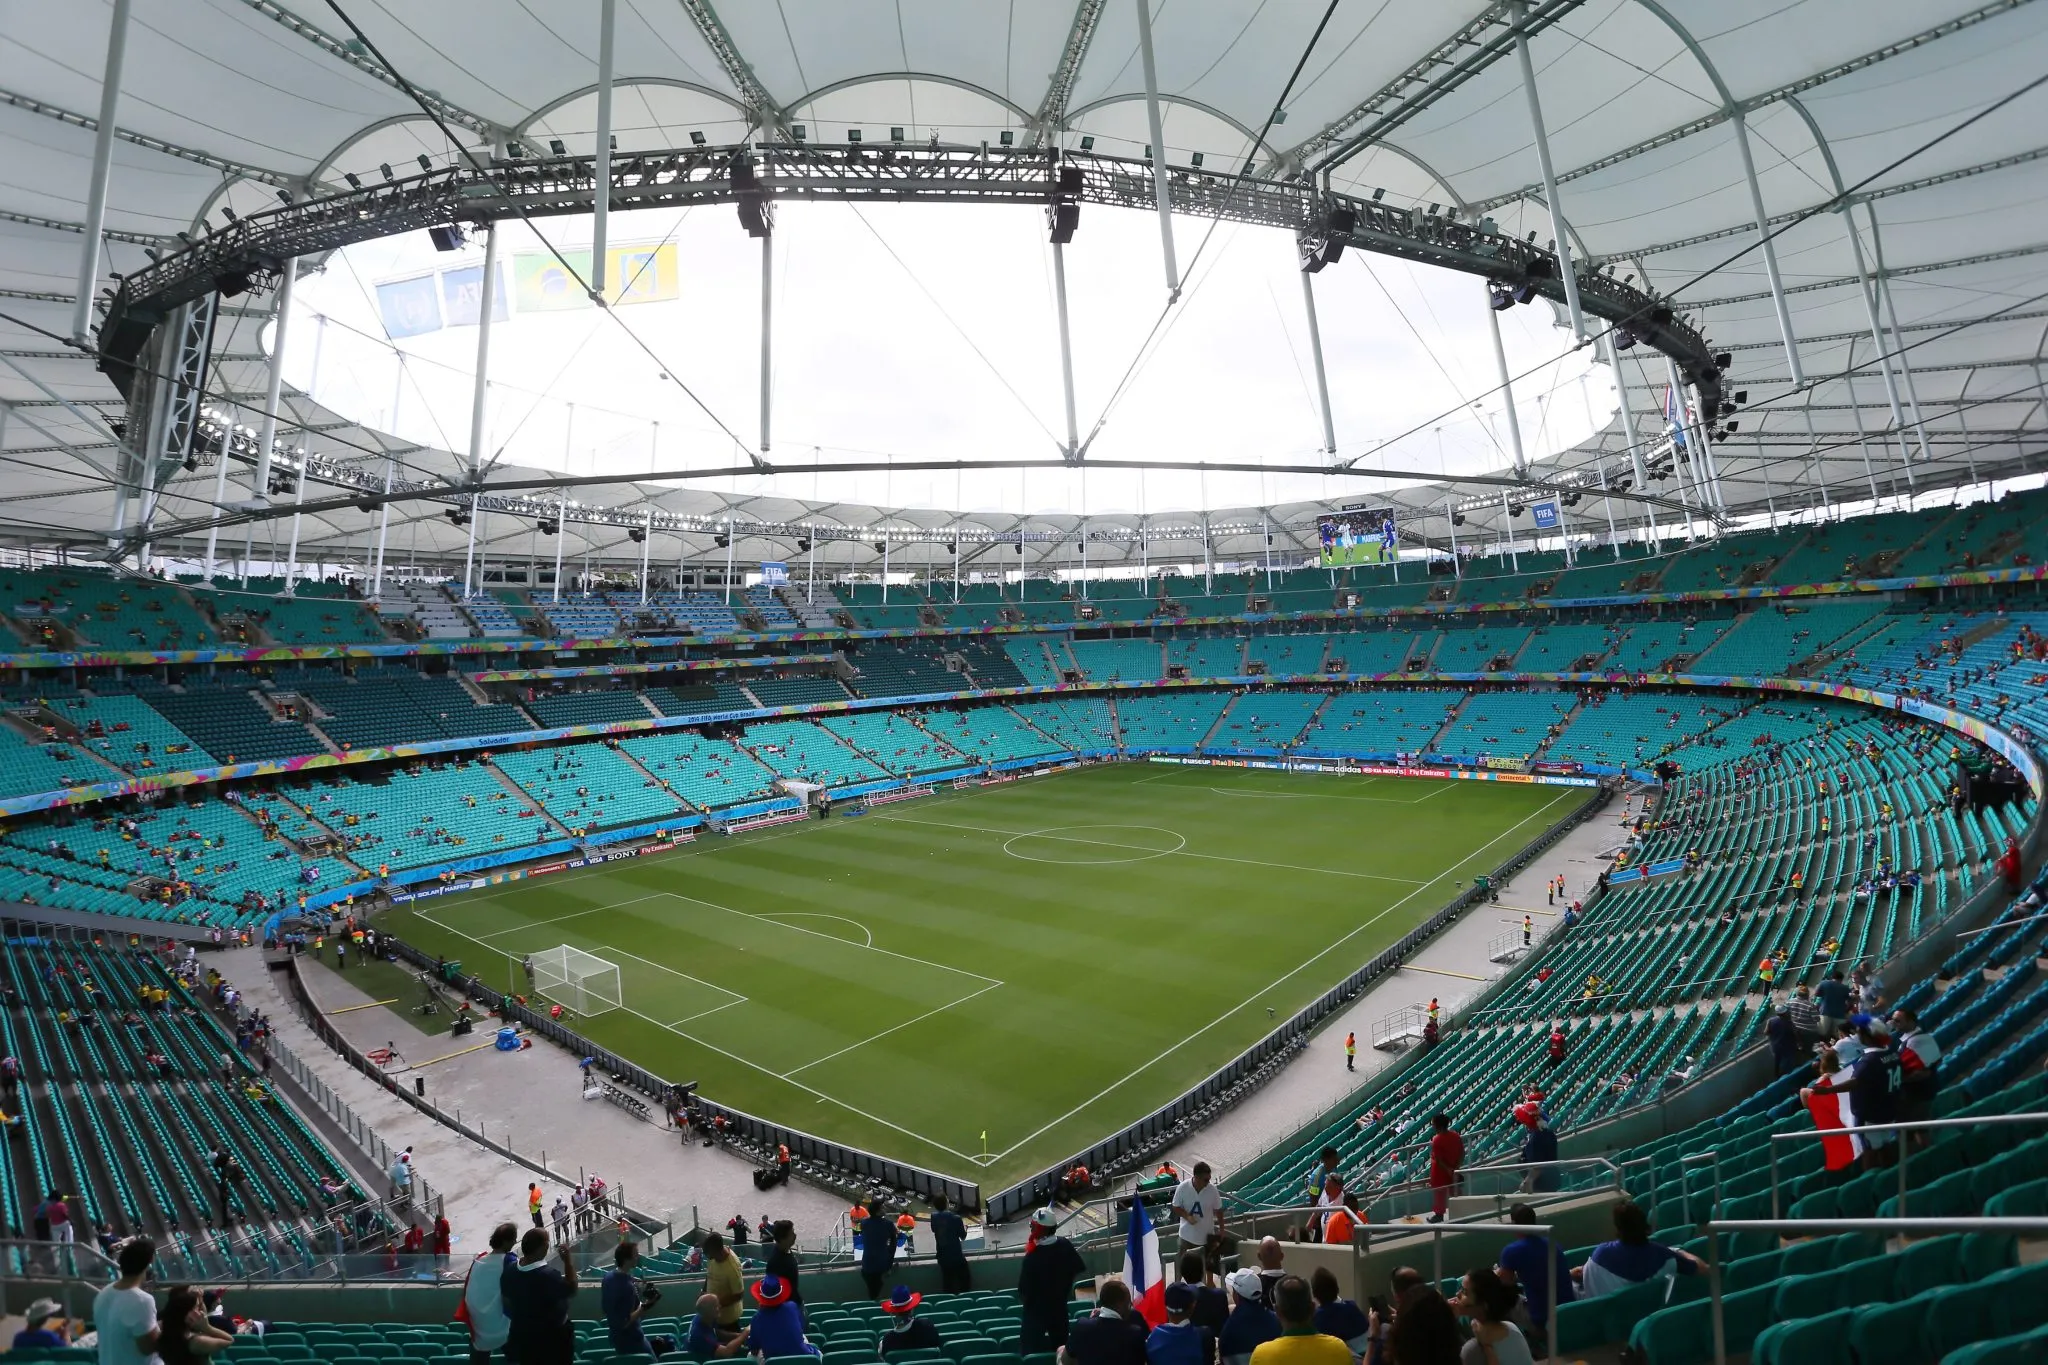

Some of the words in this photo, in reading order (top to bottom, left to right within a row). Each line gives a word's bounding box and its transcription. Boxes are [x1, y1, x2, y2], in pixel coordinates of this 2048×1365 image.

[1536, 508, 1554, 519] FIFA
[764, 567, 784, 577] FIFA
[713, 713, 729, 721] World
[478, 736, 511, 746] Salvador
[1335, 765, 1362, 773] adidas
[1420, 769, 1446, 777] Emirates
[1545, 777, 1569, 785] YINGLI
[1570, 778, 1597, 787] SOLAR
[641, 847, 652, 855] Fly
[652, 842, 674, 853] Emirates
[588, 856, 604, 865] VISA
[607, 849, 638, 862] SONY
[569, 859, 585, 869] VISA
[533, 865, 561, 875] McDonald's
[444, 882, 471, 892] MARFRIG
[393, 893, 417, 903] YINGLI
[417, 889, 440, 899] SOLAR
[1887, 1065, 1902, 1093] 14
[1190, 1201, 1204, 1218] A
